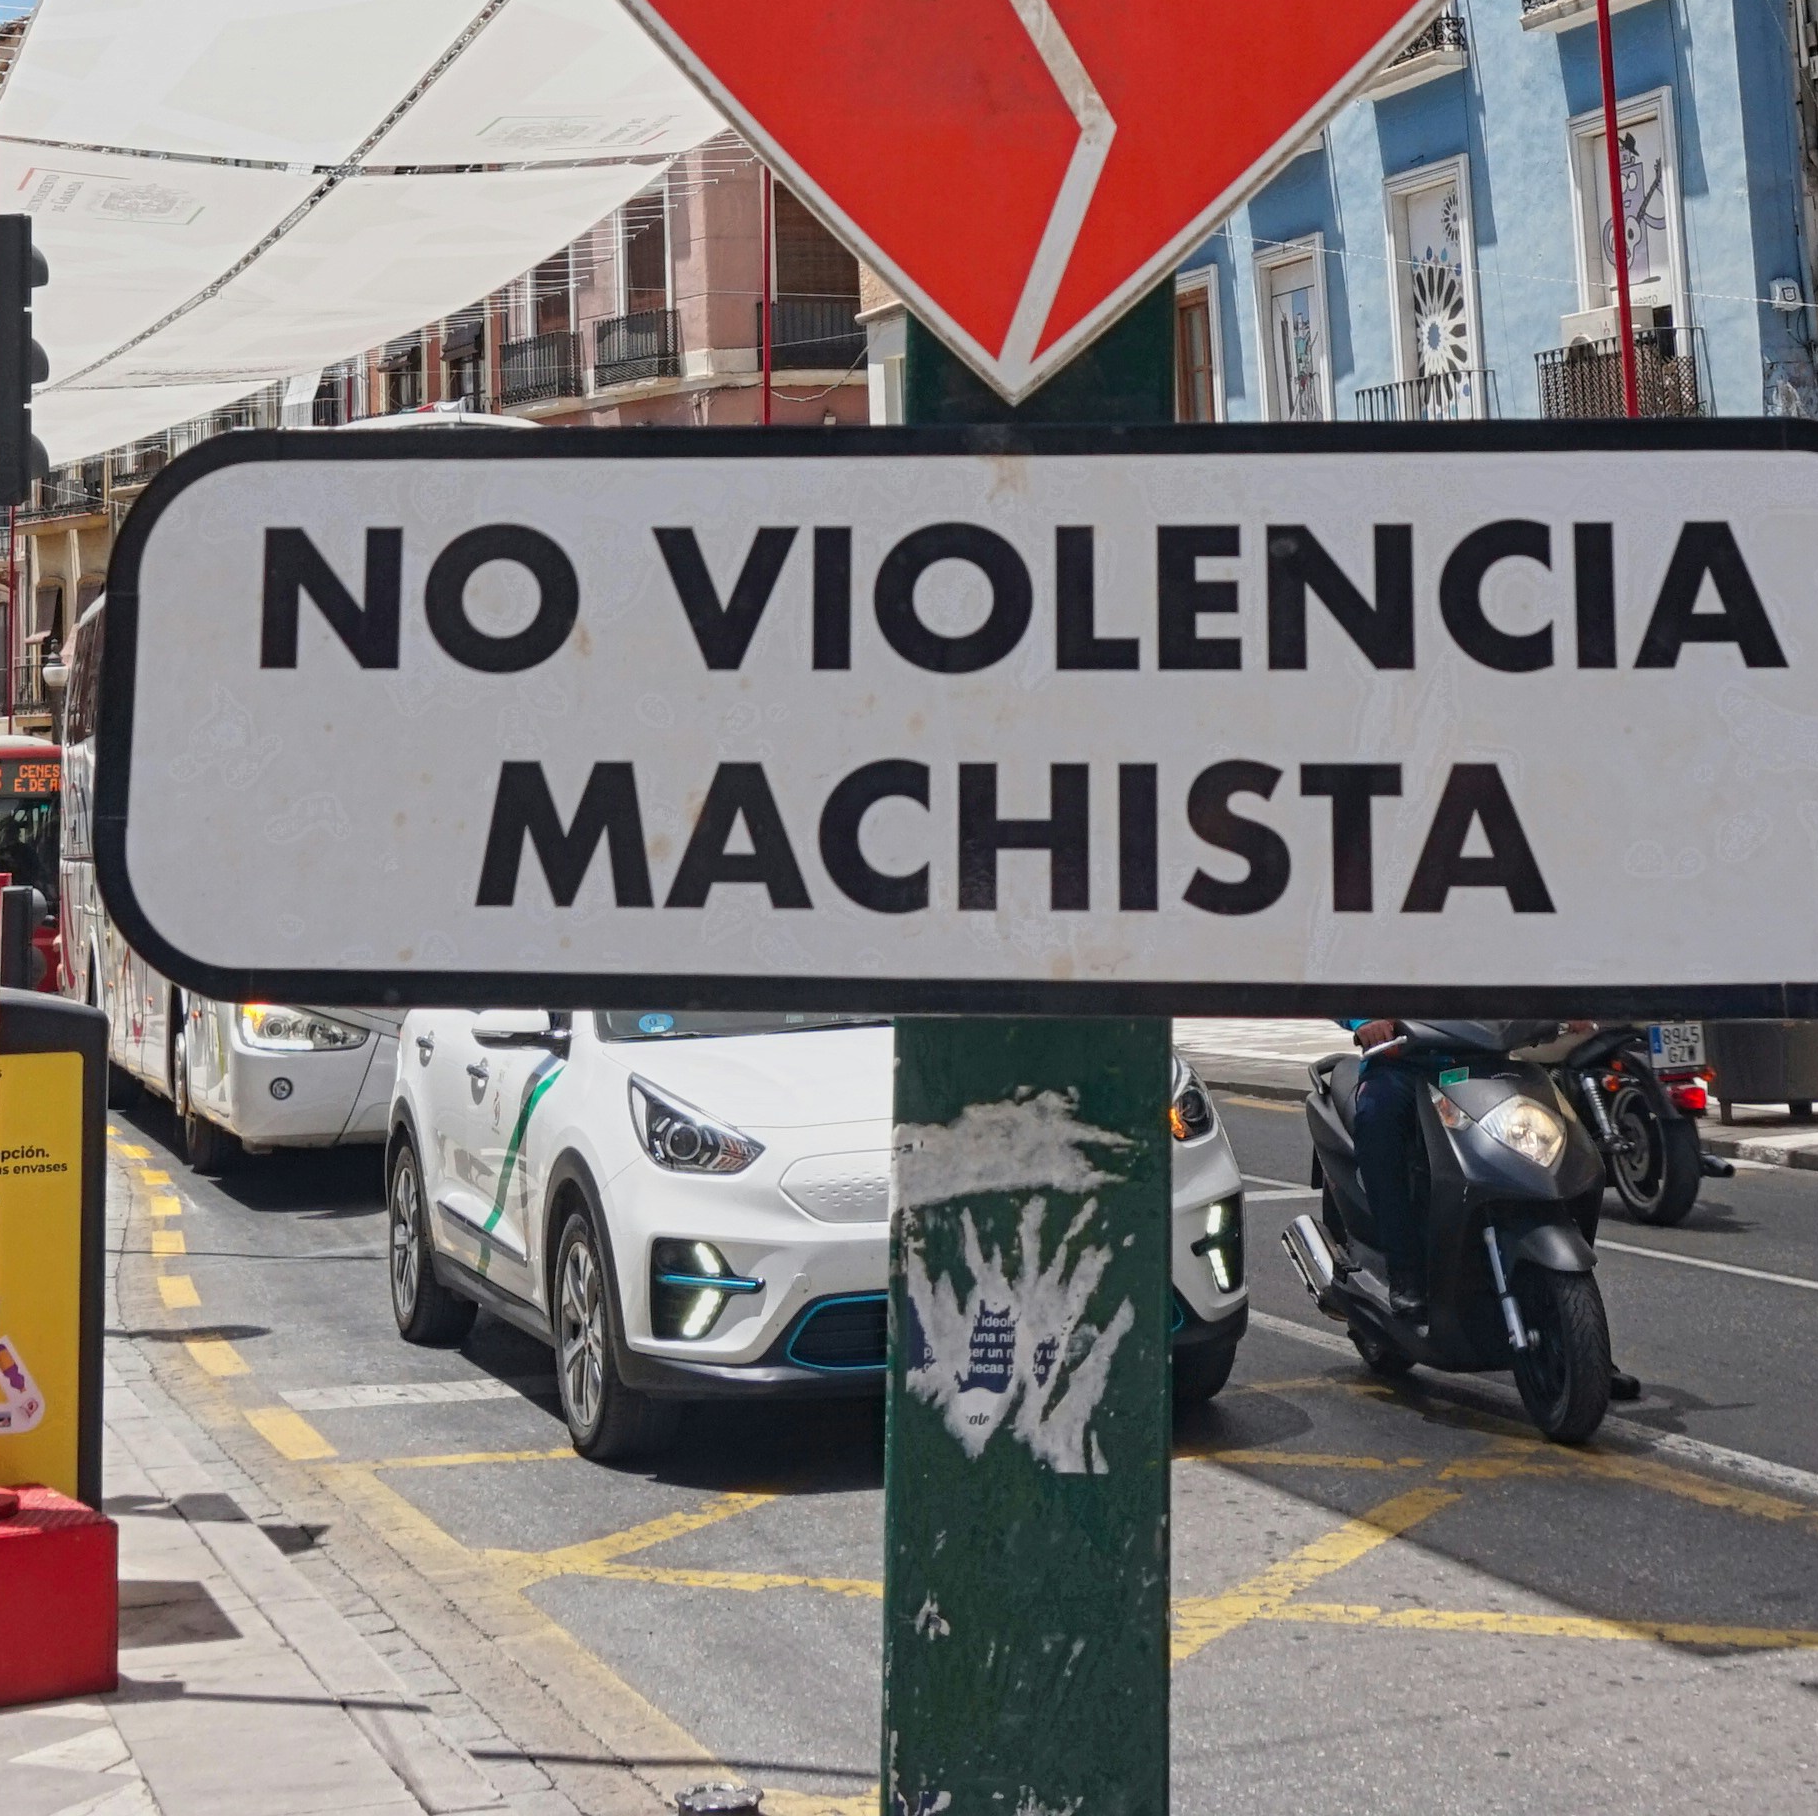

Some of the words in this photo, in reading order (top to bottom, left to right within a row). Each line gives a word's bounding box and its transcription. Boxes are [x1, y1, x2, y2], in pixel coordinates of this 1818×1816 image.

[261, 521, 581, 674] NO
[654, 519, 1790, 674] VIOLENCIA
[19, 764, 60, 778] CENES
[29, 778, 46, 792] DE
[475, 760, 1557, 915] MACHISTA
[13, 1161, 69, 1174] envases
[973, 1333, 996, 1343] una
[972, 1349, 985, 1358] er
[988, 1348, 1004, 1358] un
[968, 1362, 1004, 1375] ñecas
